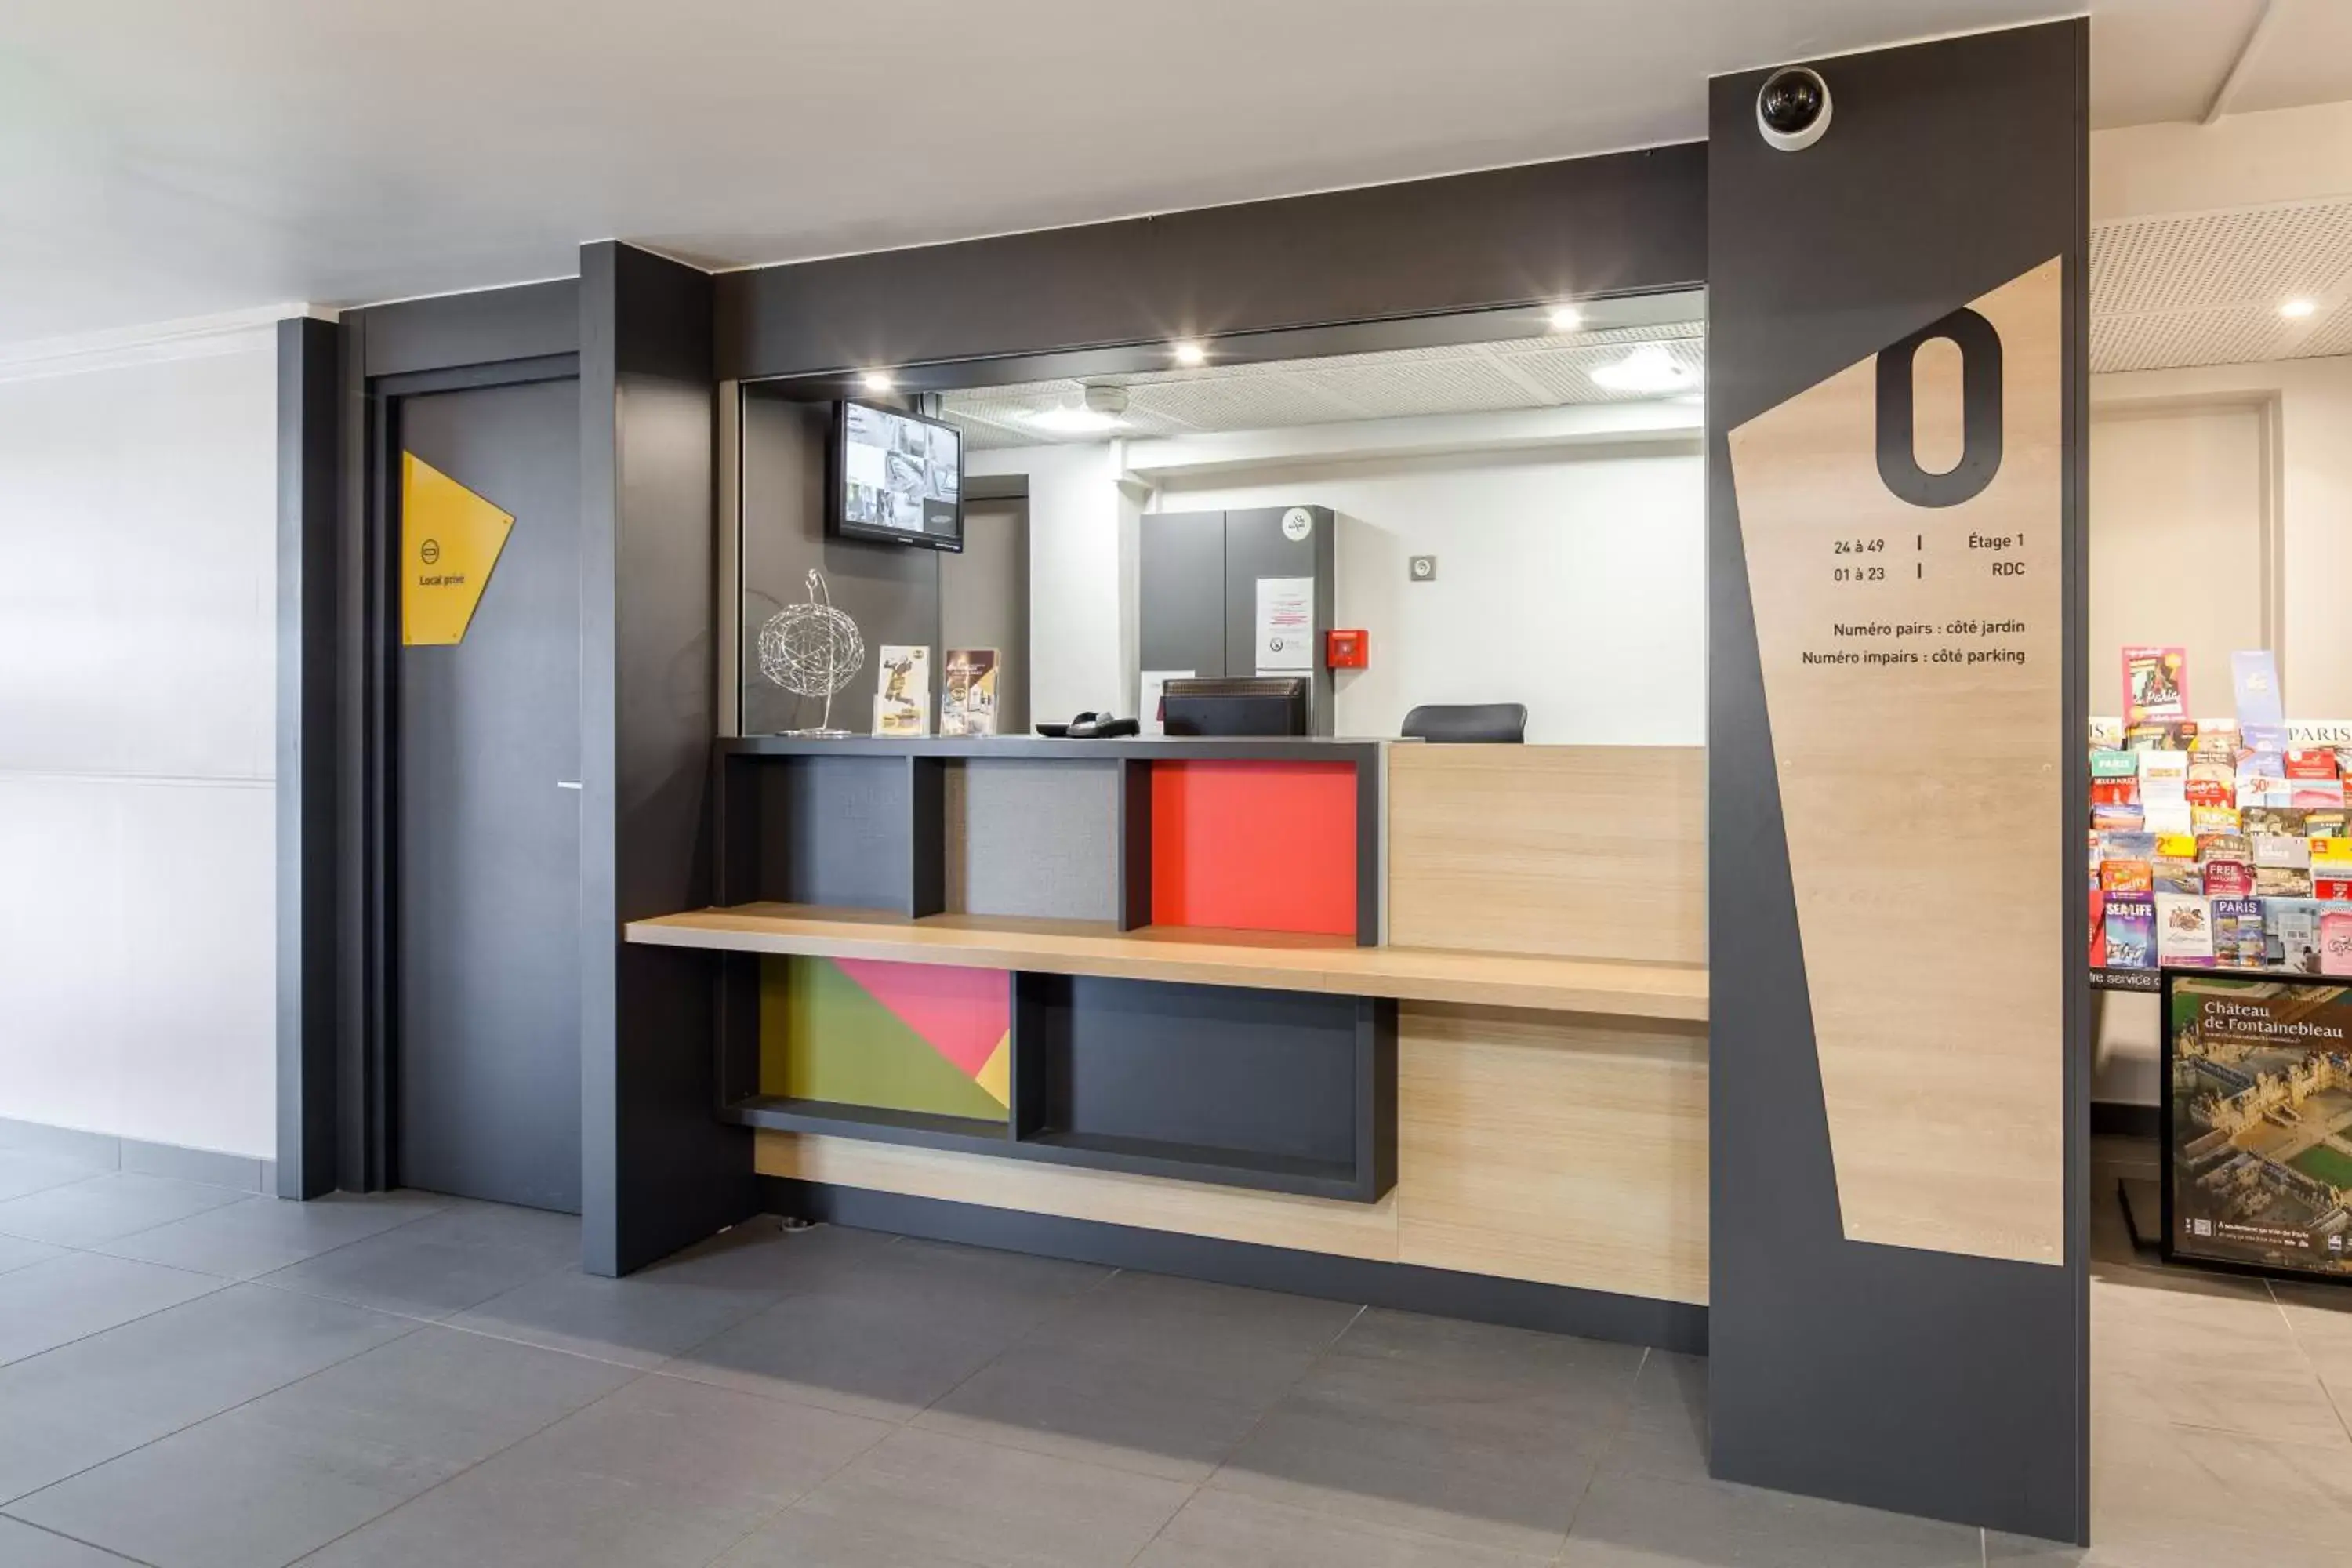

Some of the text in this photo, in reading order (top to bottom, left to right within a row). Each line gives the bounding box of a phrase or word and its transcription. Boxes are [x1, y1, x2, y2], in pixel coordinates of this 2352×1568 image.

[1833, 540, 1851, 554] 24
[1854, 539, 1864, 553] à
[1867, 539, 1885, 553] 49
[1969, 532, 2012, 551] Étage
[2017, 532, 2024, 546] 1
[1833, 568, 1850, 582] 01
[1855, 567, 1864, 581] à
[1867, 567, 1885, 581] 23
[1991, 561, 2026, 576] RDC
[419, 575, 441, 586] Local
[1833, 622, 1892, 636] Numéro
[1896, 622, 1933, 638] pairs
[1946, 619, 1978, 634] côté
[1981, 619, 2025, 637] jardin
[1802, 651, 1860, 664] Numéro
[1864, 649, 1919, 666] impairs
[1931, 648, 1962, 663] côté
[1967, 648, 2026, 666] parking
[2288, 726, 2351, 742] PARIS
[2209, 864, 2239, 876] FREE
[2107, 902, 2128, 916] SEA
[2219, 901, 2258, 913] PARIS
[2107, 972, 2151, 986] service
[2204, 1000, 2270, 1017] Château
[2205, 1016, 2224, 1029] de
[2228, 1018, 2343, 1039] Fontainebleau
